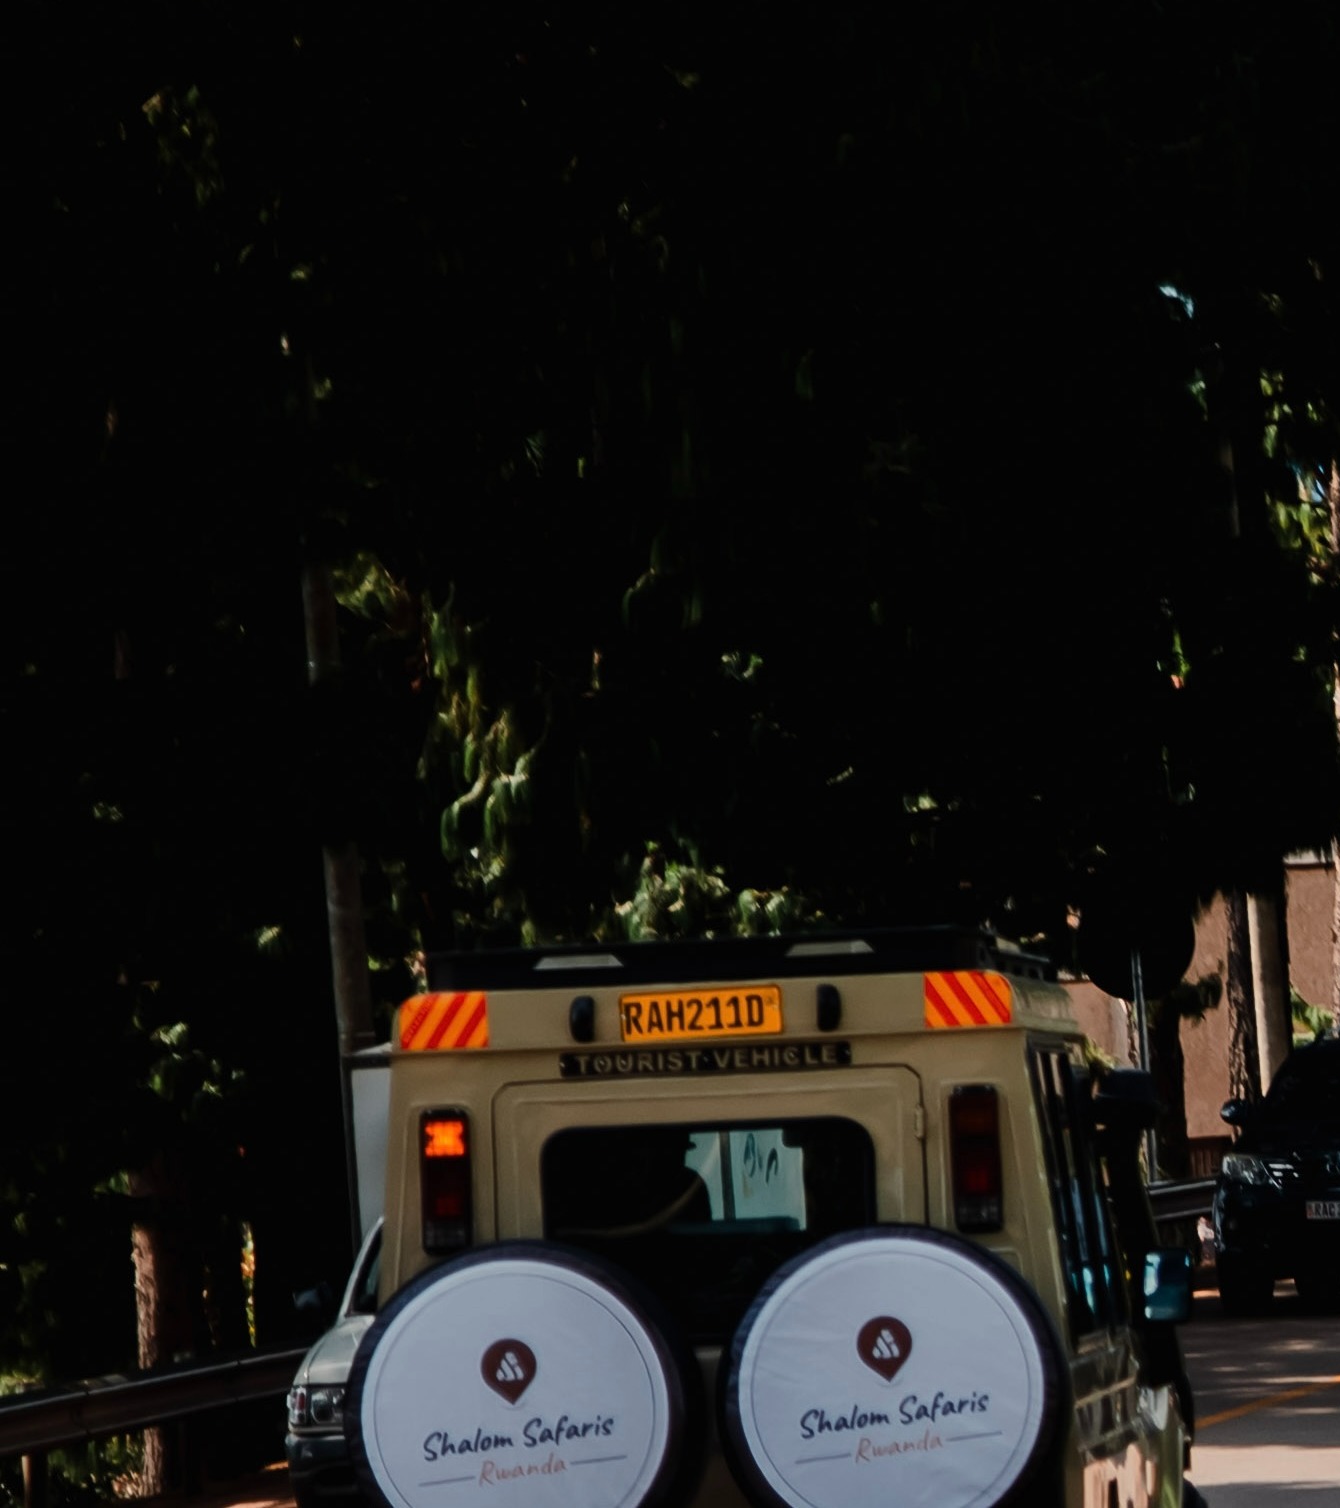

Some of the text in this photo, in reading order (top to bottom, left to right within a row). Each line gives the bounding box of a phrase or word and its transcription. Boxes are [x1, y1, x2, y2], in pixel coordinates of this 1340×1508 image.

[622, 994, 765, 1035] RAH211D
[574, 1044, 837, 1075] TOURIST VEHICLE
[800, 1391, 990, 1439] Shalom Safaris
[423, 1415, 615, 1462] Shalom Safaris
[855, 1429, 944, 1464] Rwanda
[477, 1452, 568, 1486] Rwanda
